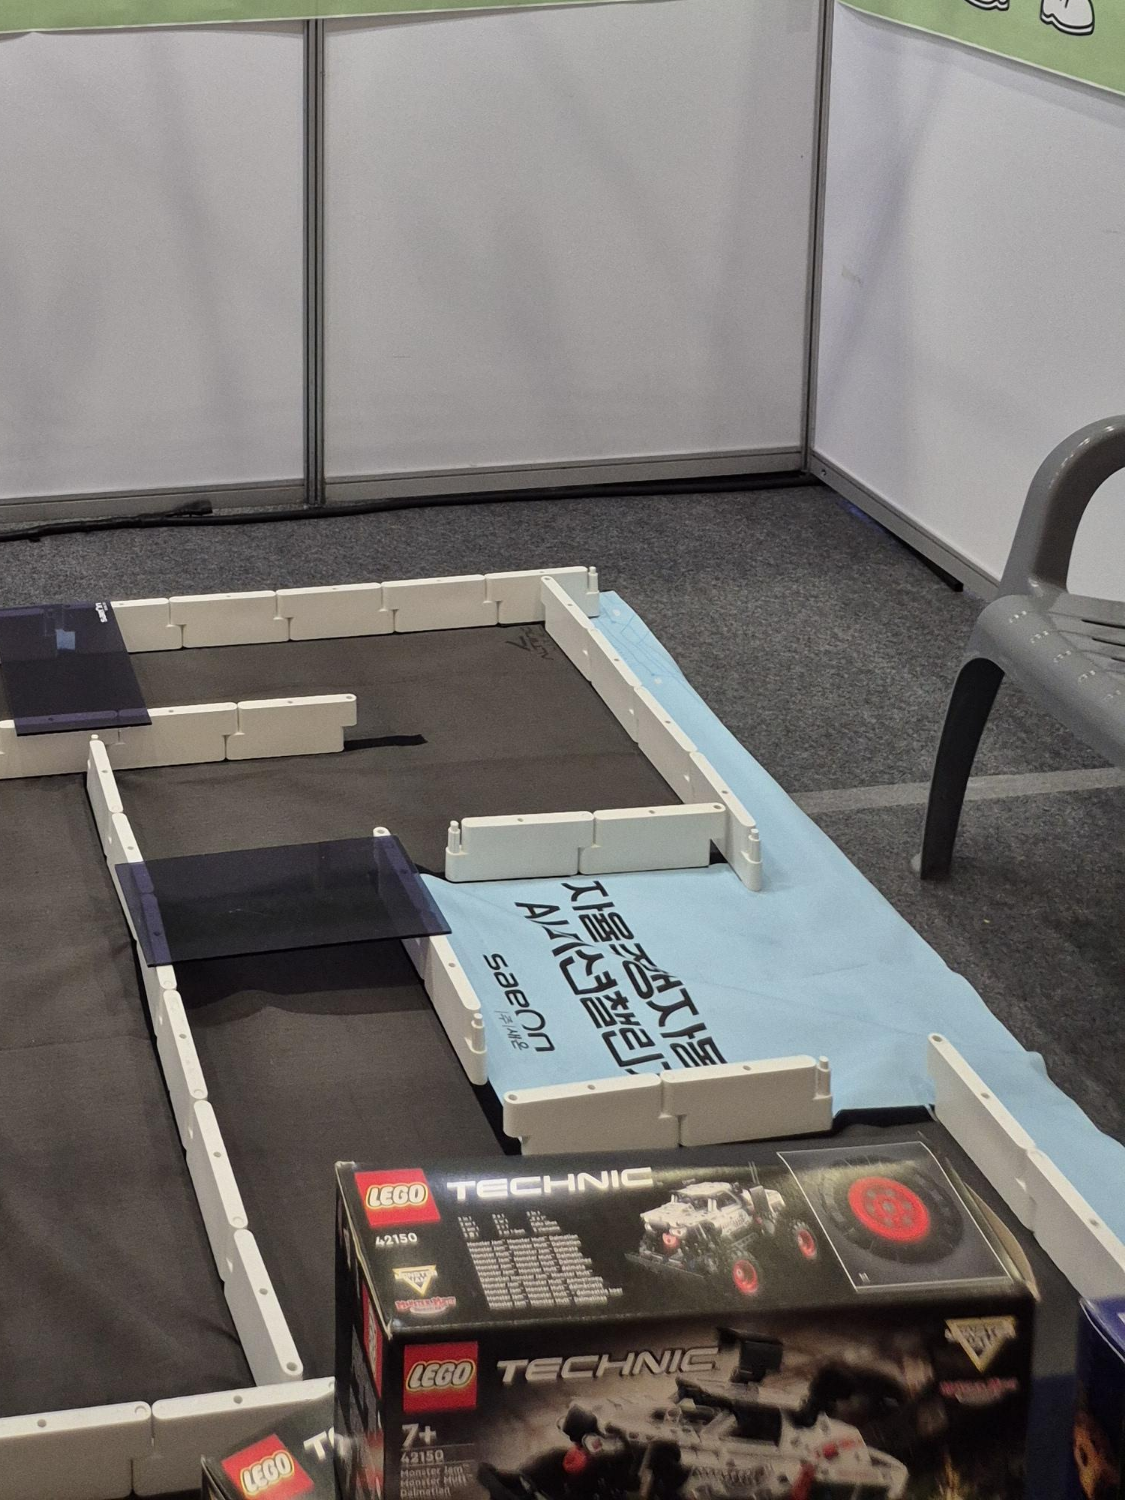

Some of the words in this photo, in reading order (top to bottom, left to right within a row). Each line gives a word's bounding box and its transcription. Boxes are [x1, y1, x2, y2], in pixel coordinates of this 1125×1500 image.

[366, 1183, 428, 1210] LEGO
[447, 1167, 653, 1201] TECHNIC
[375, 1232, 418, 1246] 42150
[406, 1359, 475, 1392] LEGO
[497, 1346, 720, 1385] TECHNIC
[401, 1423, 437, 1449] 7+
[241, 1450, 294, 1496] LEGO
[400, 1449, 445, 1464] 42150
